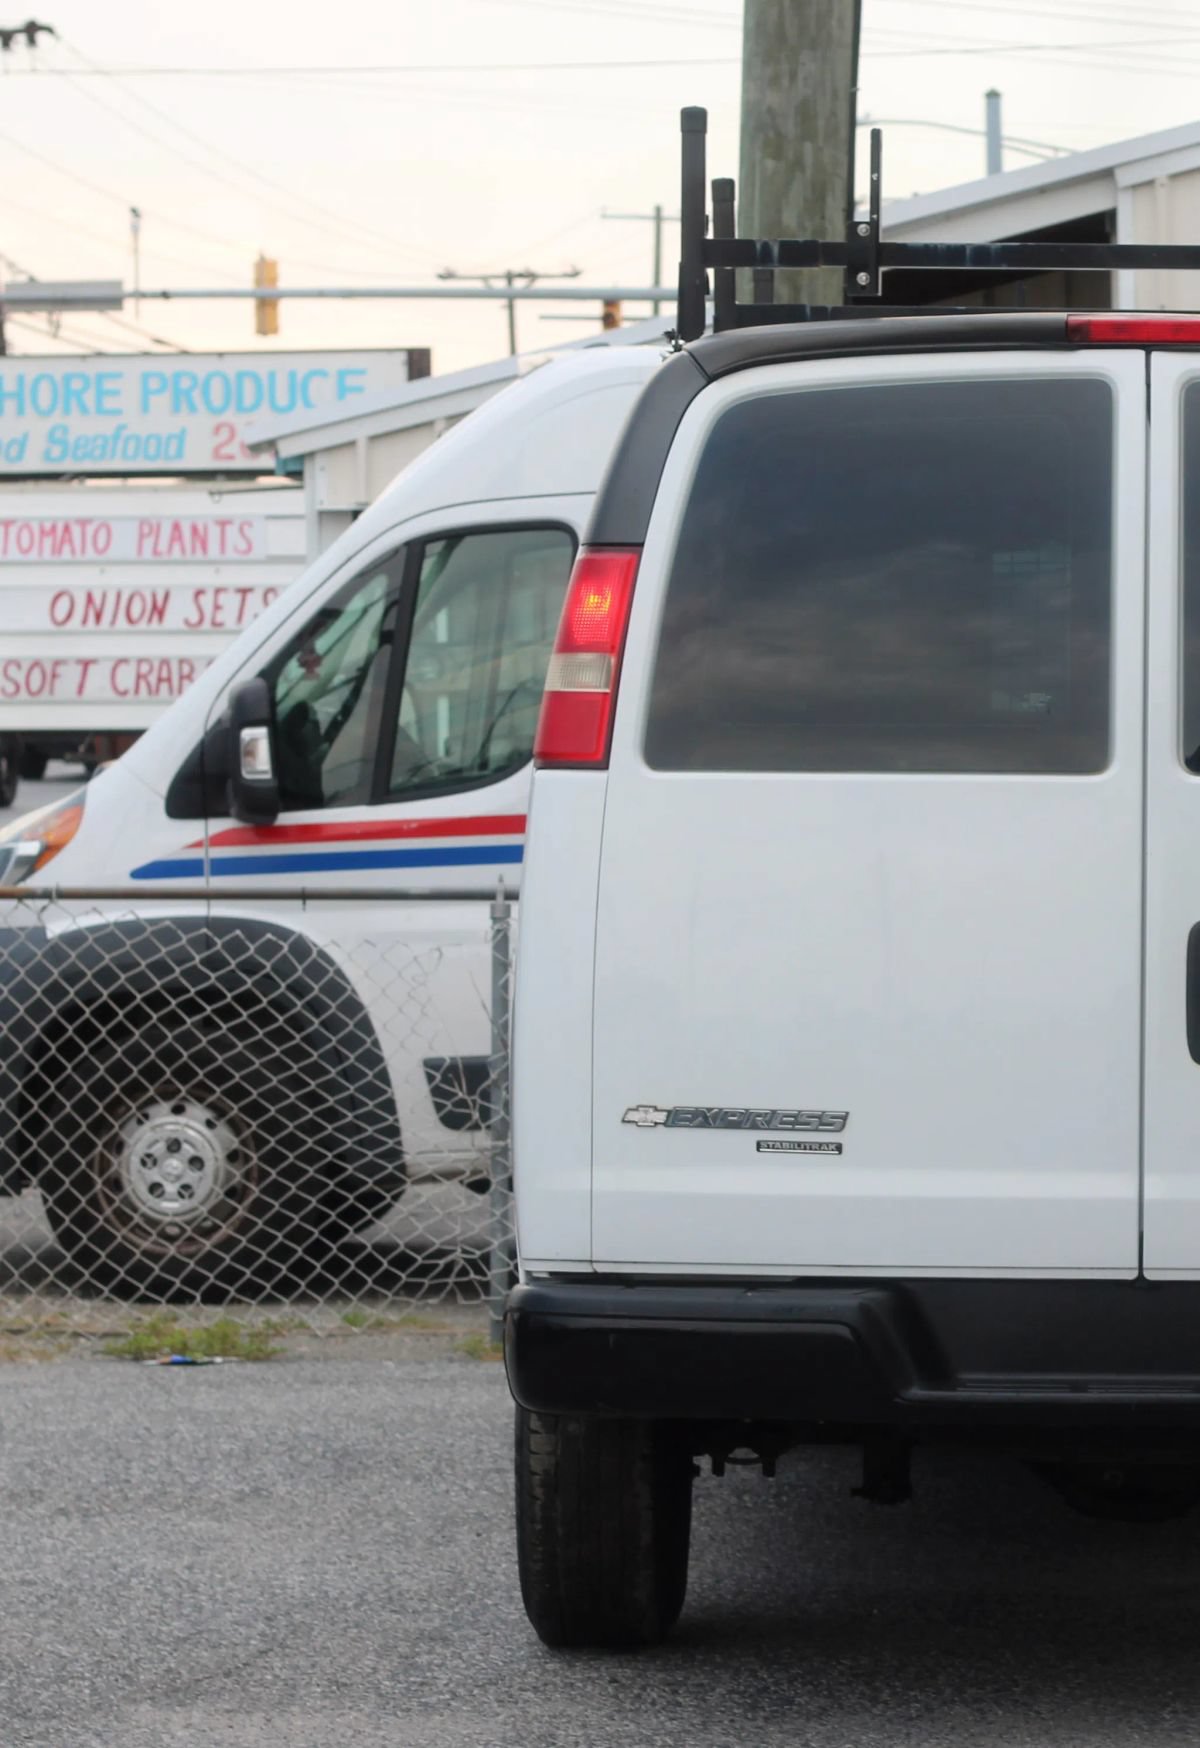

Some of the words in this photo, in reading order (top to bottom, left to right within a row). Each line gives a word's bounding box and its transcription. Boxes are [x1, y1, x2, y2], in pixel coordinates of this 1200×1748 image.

[43, 423, 188, 463] Seafood
[0, 518, 113, 557] TOMATO
[136, 519, 254, 557] PLANTS
[49, 587, 171, 627] ONION
[0, 658, 98, 698] SOFT
[667, 1106, 849, 1132] EXPRESS
[759, 1141, 839, 1152] STABILITRAK
